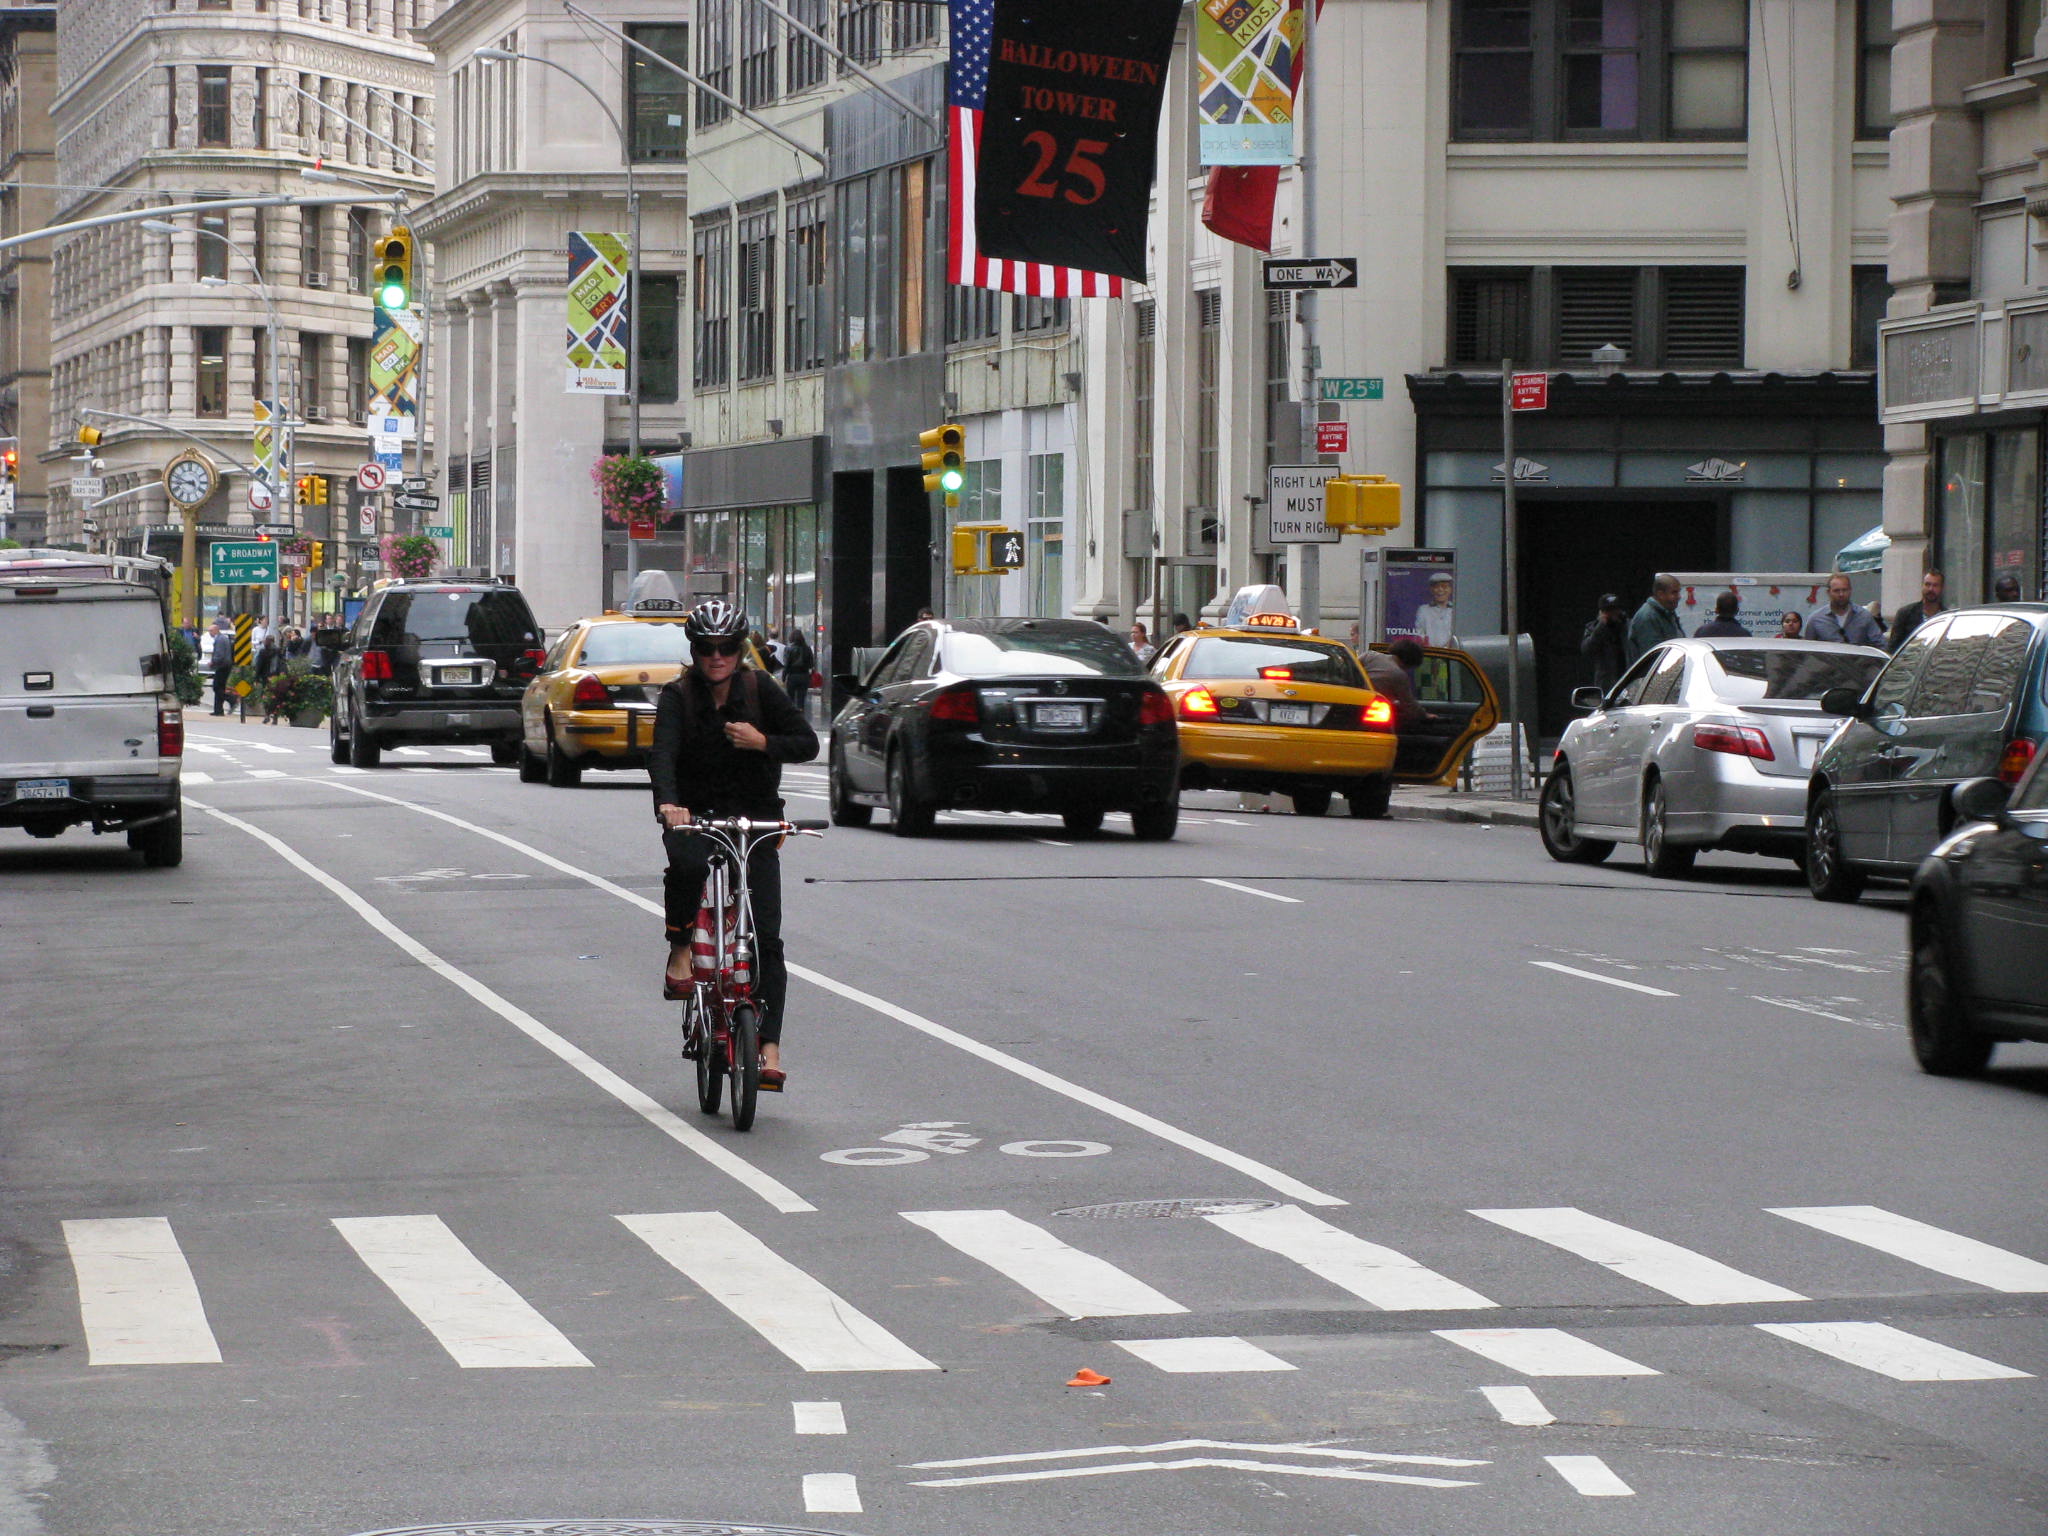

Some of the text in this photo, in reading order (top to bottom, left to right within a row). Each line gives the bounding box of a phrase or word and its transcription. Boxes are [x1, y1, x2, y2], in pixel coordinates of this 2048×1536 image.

[1237, 6, 1275, 41] KIDS.
[1000, 38, 1160, 86] HALLOWEEN
[1021, 86, 1118, 122] TOWER
[1016, 131, 1110, 205] 25
[1277, 267, 1343, 280] ONE WAY
[1521, 376, 1545, 385] STANDING
[1325, 379, 1382, 398] W 25 ST
[1518, 386, 1541, 395] ANYTIME
[1326, 424, 1347, 432] STANDING
[1273, 476, 1304, 489] RIGHT
[1287, 497, 1323, 512] MUST
[424, 527, 430, 536] W
[432, 527, 443, 536] 24
[1273, 522, 1301, 534] TURN
[231, 549, 272, 558] BROADWAY
[220, 569, 244, 578] 5 AVE
[1260, 616, 1284, 627] 4V29
